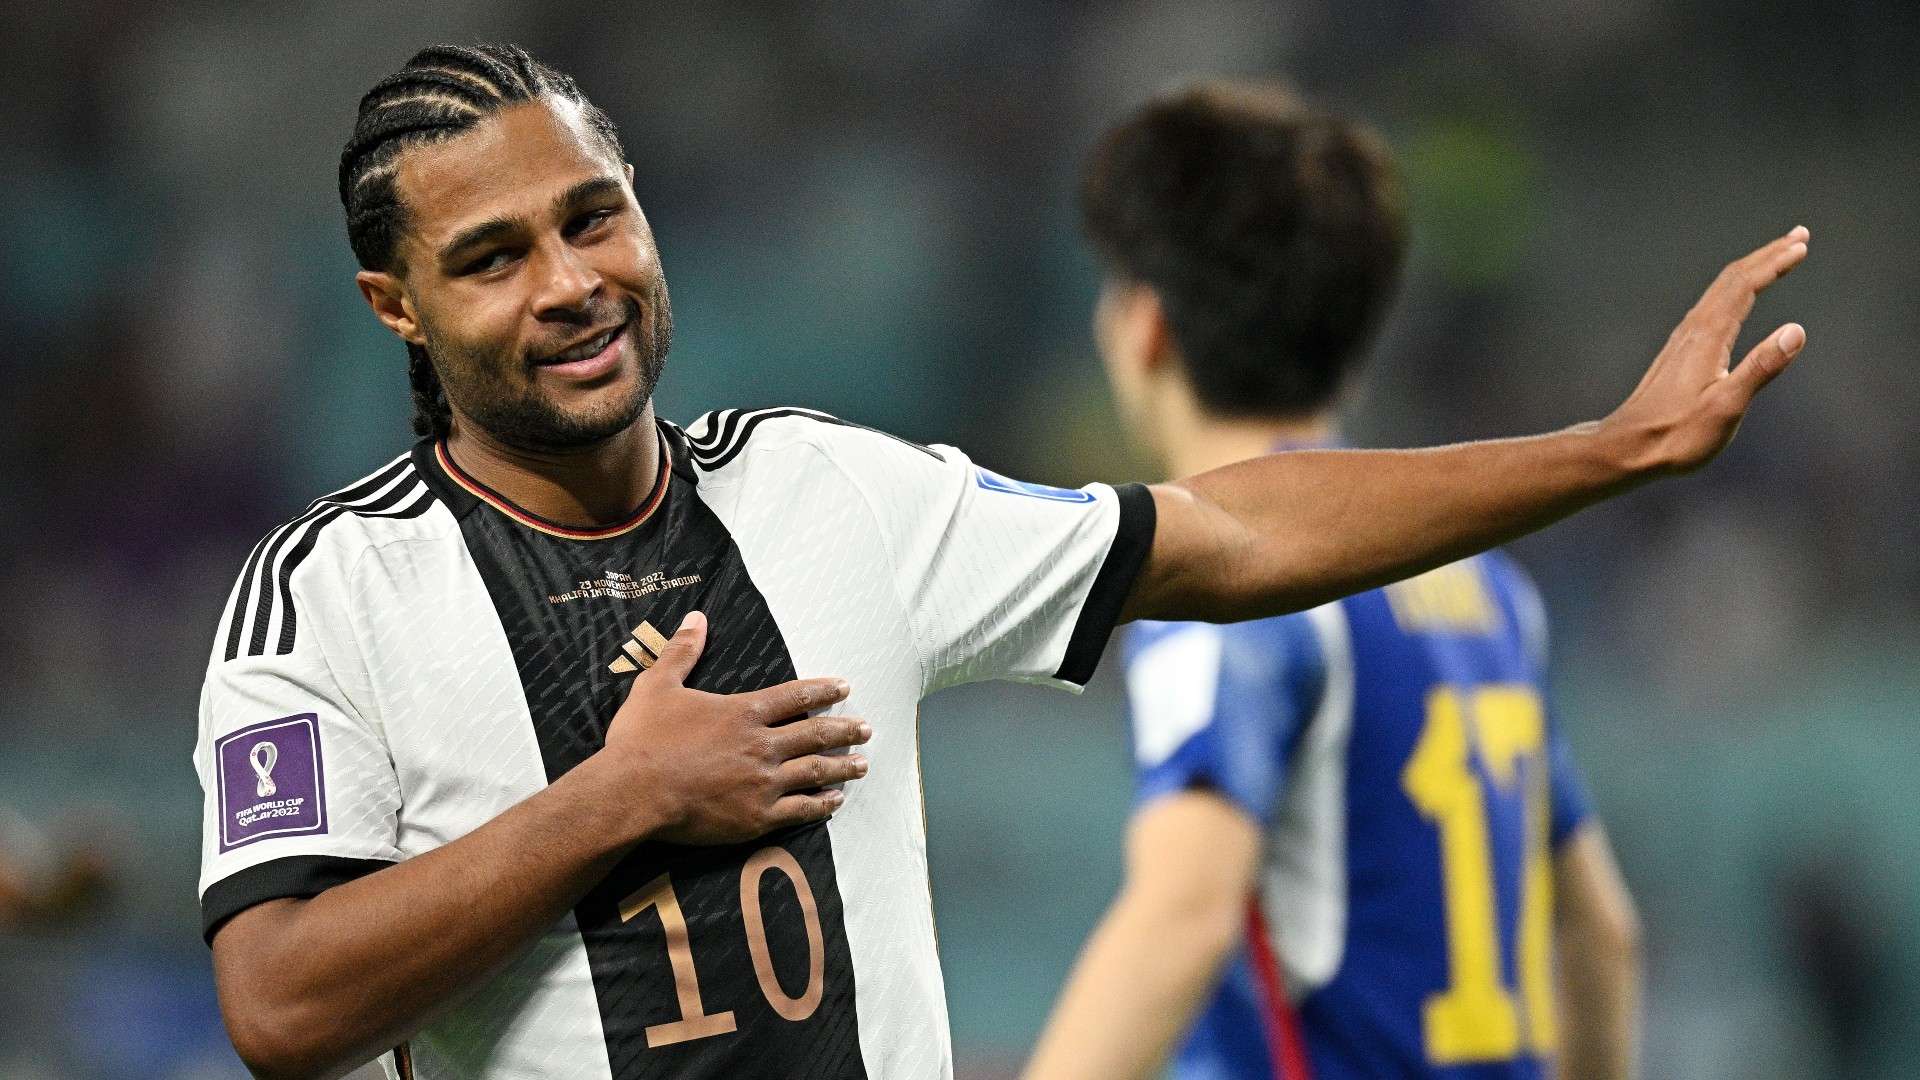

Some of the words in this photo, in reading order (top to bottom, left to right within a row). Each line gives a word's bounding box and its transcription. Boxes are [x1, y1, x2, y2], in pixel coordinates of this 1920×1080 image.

[580, 580, 592, 590] 23
[595, 578, 639, 591] NOVEMBER
[640, 572, 665, 585] 2022
[605, 571, 632, 581] JAPAN
[548, 591, 589, 604] KHALIFA
[591, 582, 661, 599] INTERNATIONAL
[661, 574, 702, 590] STADIUM
[236, 808, 253, 819] FIFA
[253, 801, 284, 812] WORLD
[286, 798, 304, 806] CUP
[618, 846, 825, 1048] 10
